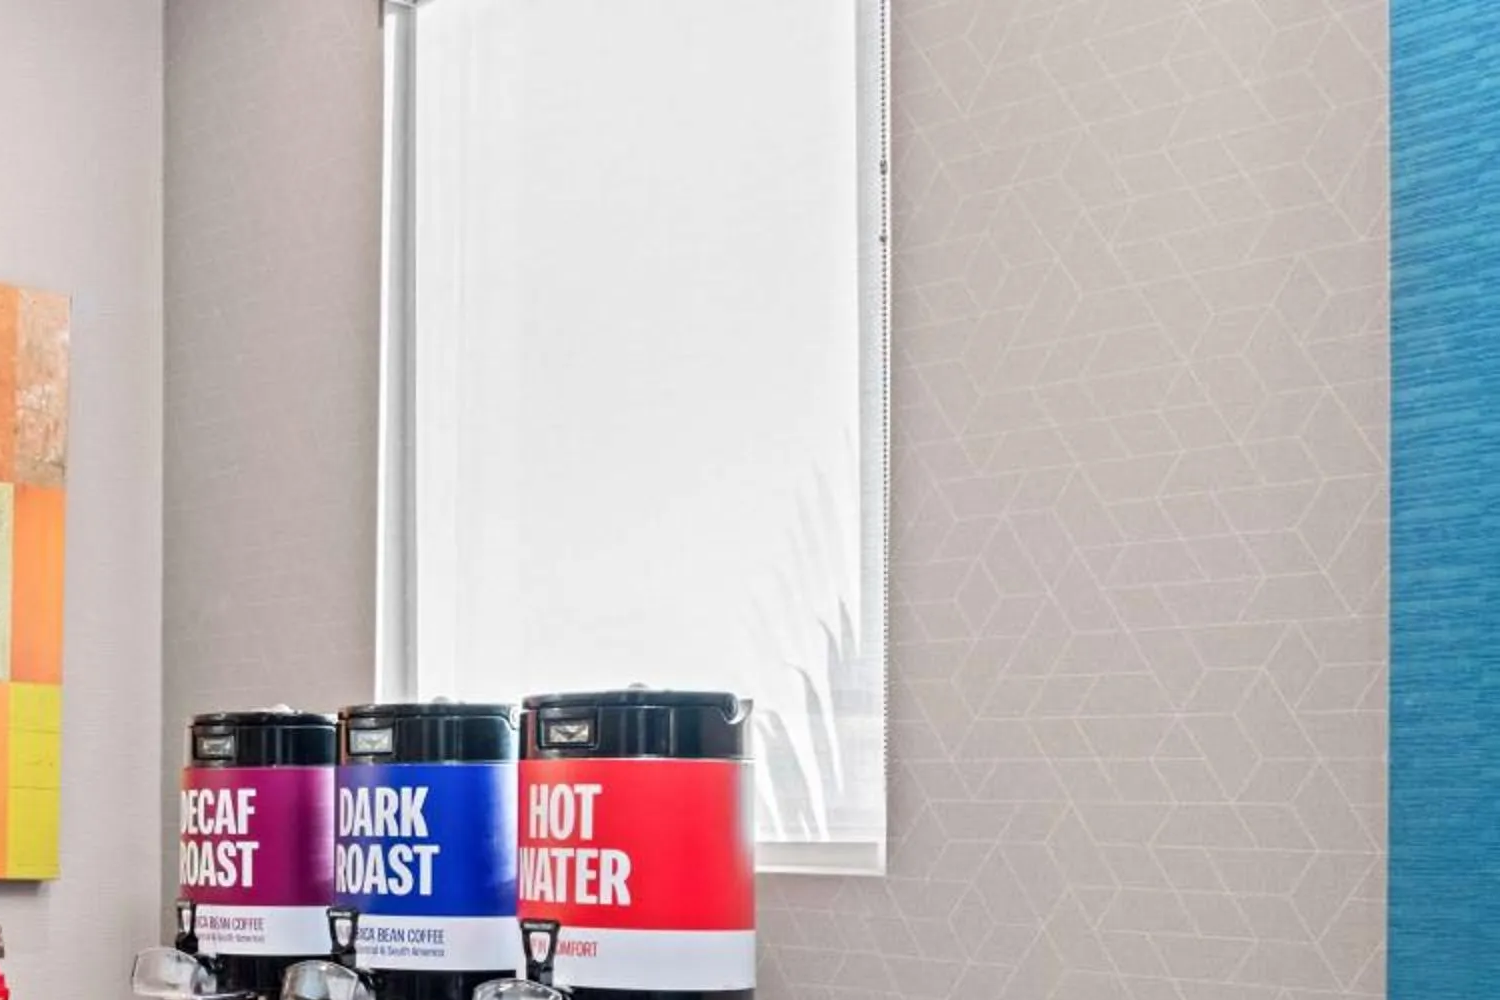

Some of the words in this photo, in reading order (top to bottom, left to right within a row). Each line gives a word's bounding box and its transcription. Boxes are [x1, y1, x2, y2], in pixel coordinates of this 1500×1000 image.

[339, 786, 429, 837] DARK
[528, 783, 602, 841] HOT
[336, 843, 440, 896] ROAST
[377, 927, 405, 943] BEAN
[407, 929, 445, 945] COFFEE
[556, 940, 598, 957] OMFORT
